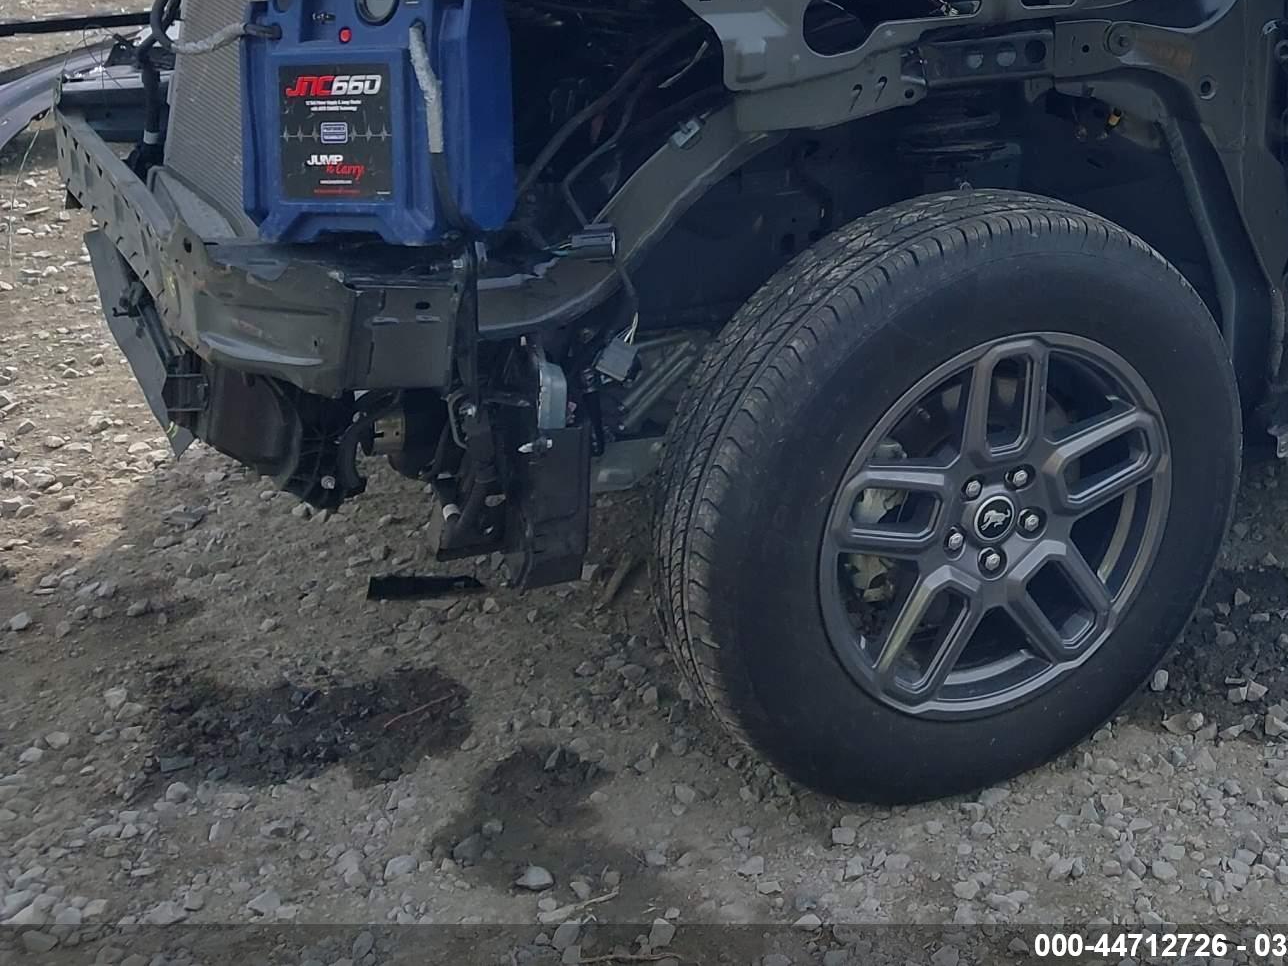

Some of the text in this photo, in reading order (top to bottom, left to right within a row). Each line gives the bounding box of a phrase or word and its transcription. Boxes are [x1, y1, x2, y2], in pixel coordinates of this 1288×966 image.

[286, 75, 382, 96] JNC660
[306, 154, 344, 166] JUMP
[336, 163, 365, 180] Carry
